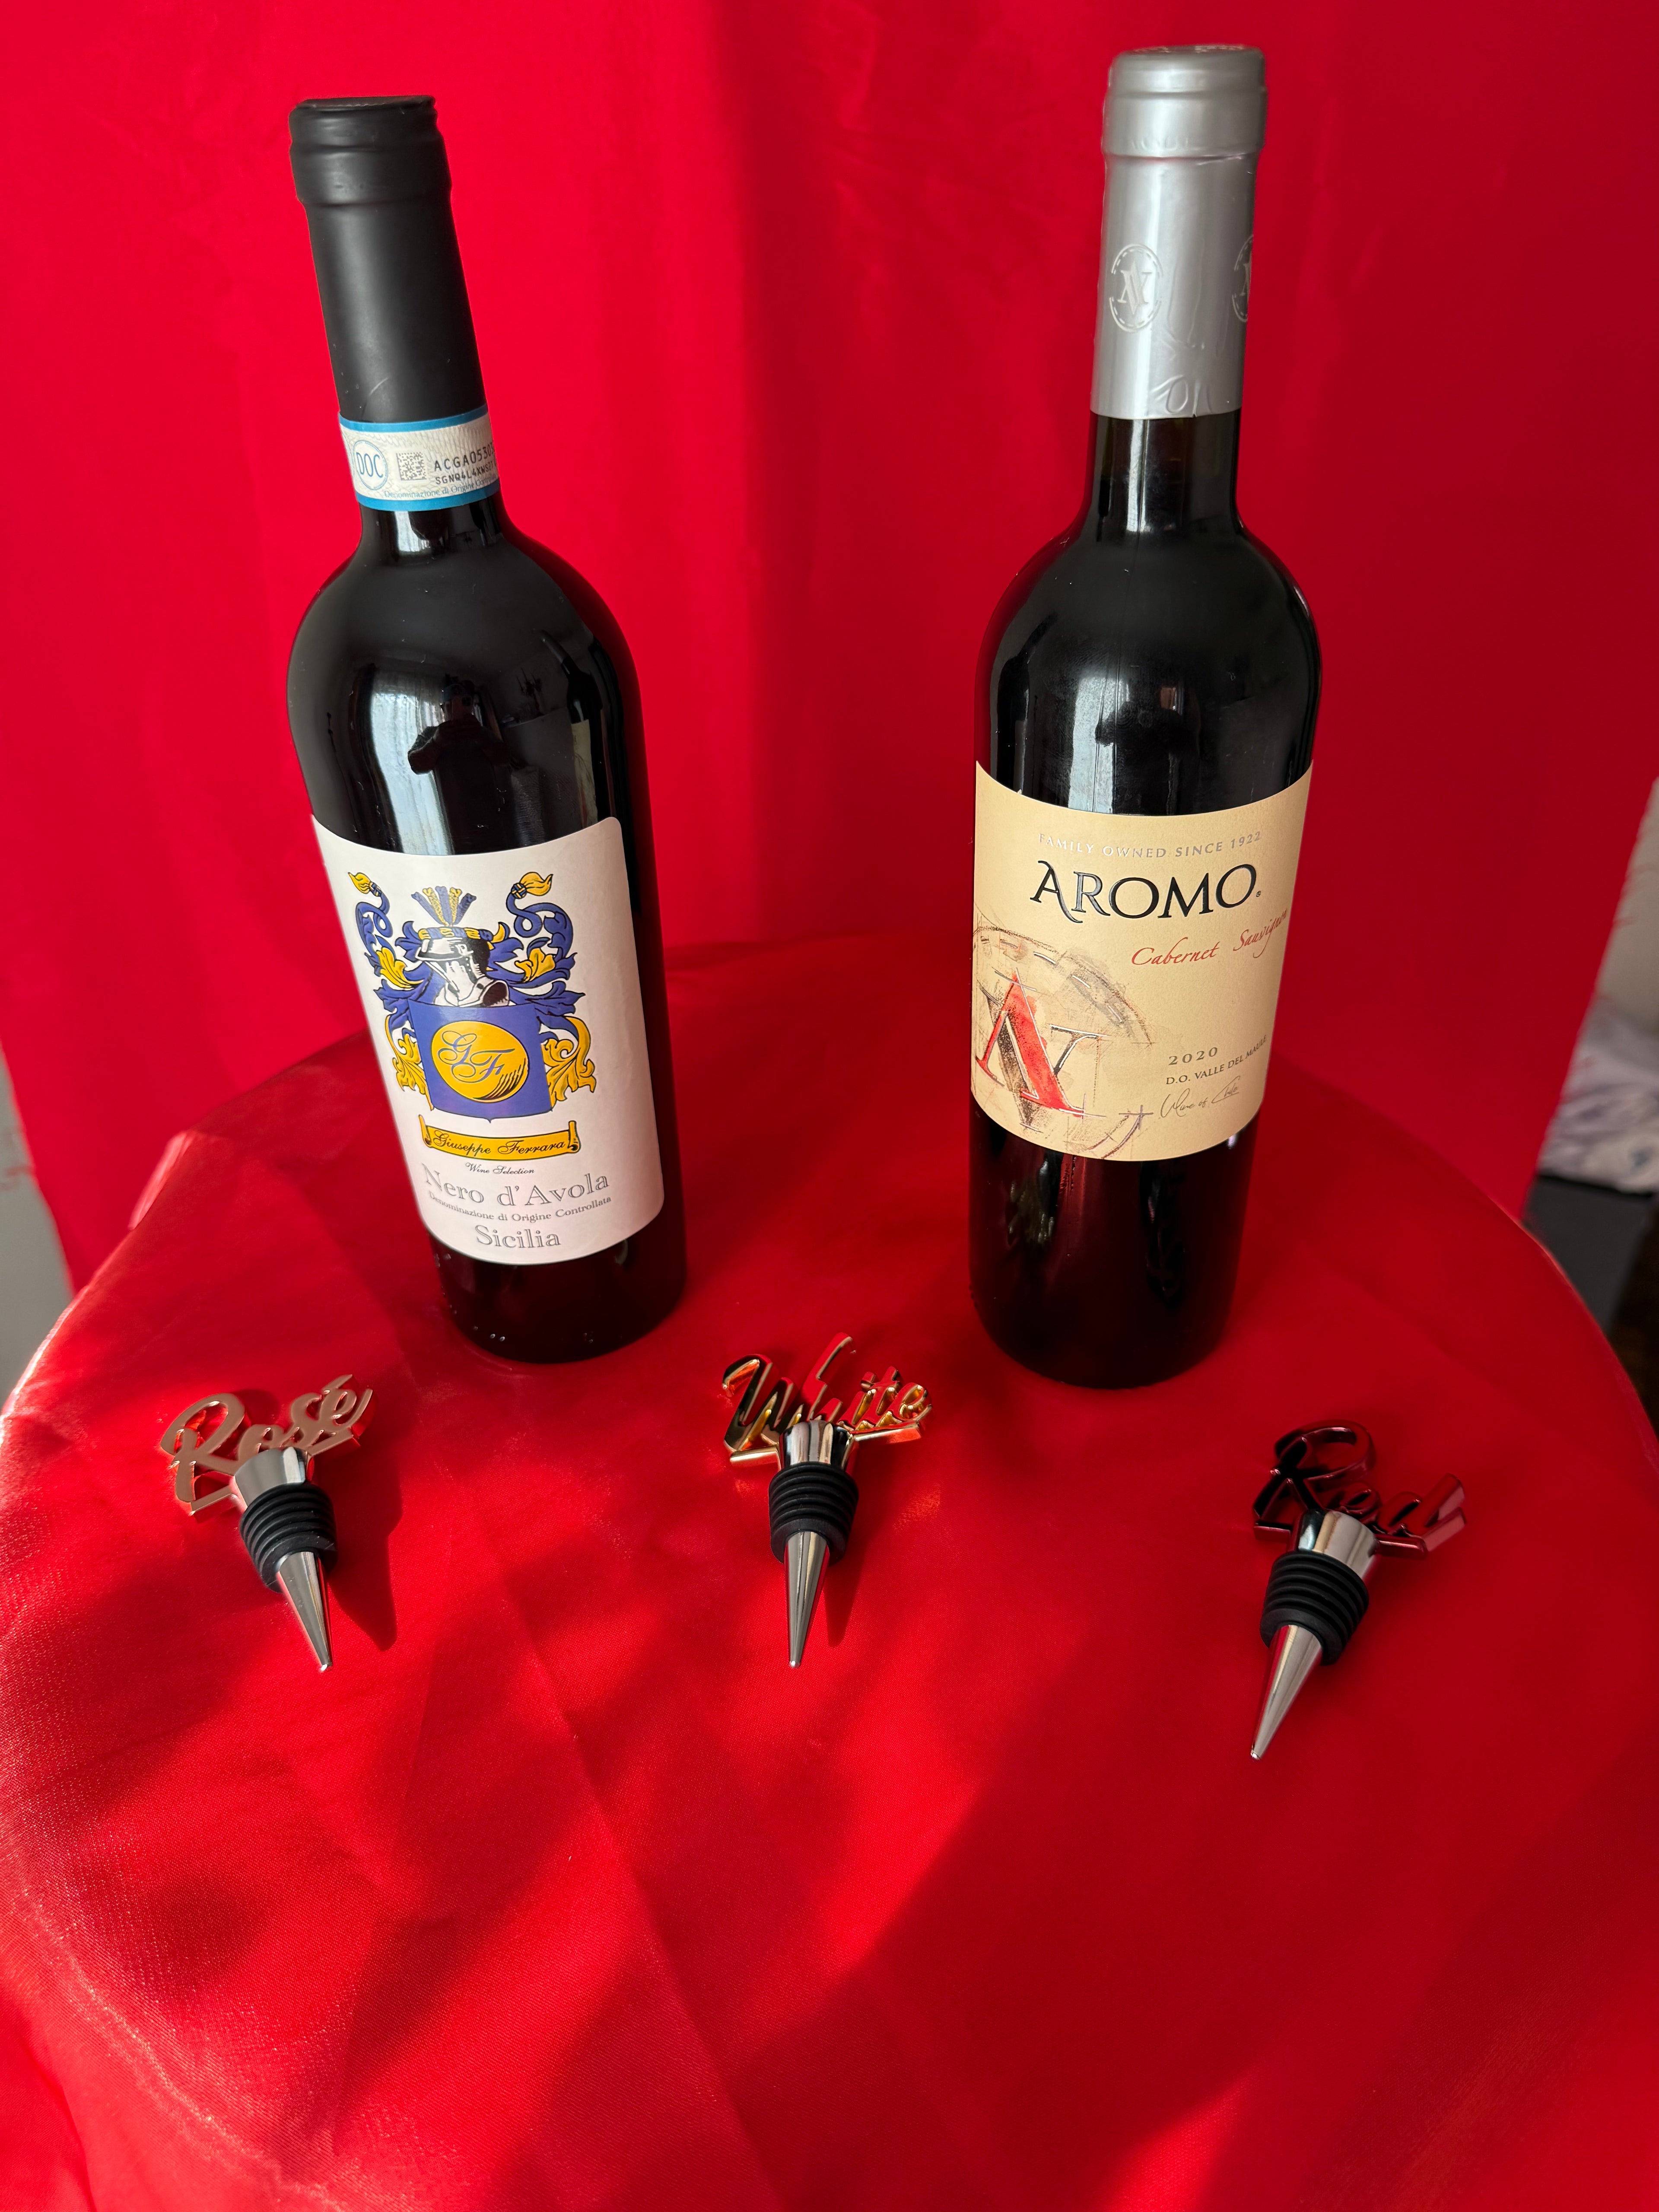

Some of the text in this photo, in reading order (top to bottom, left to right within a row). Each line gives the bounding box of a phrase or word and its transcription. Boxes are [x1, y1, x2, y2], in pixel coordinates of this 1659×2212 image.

[356, 452, 384, 478] DOC
[384, 489, 440, 498] Denominazione
[442, 486, 449, 495] di
[451, 480, 474, 493] Origine
[1038, 831, 1261, 858] FAMILY OWNED SINCE 1922
[1131, 909, 1287, 966] Cabernet Sauvignon
[438, 1031, 515, 1083] GF
[1166, 1034, 1267, 1084] D.O. VALLE DEL MAULE
[1168, 1047, 1218, 1065] 2020
[1160, 1088, 1195, 1118] Wine
[1198, 1097, 1208, 1107] of
[433, 1130, 566, 1157] Giuseppe Ferrara
[465, 1162, 535, 1175] Wine Selection
[421, 1162, 484, 1204] Nero
[429, 1190, 612, 1223] Denominazione di Origine Controllata
[475, 1224, 561, 1249] Sicilia
